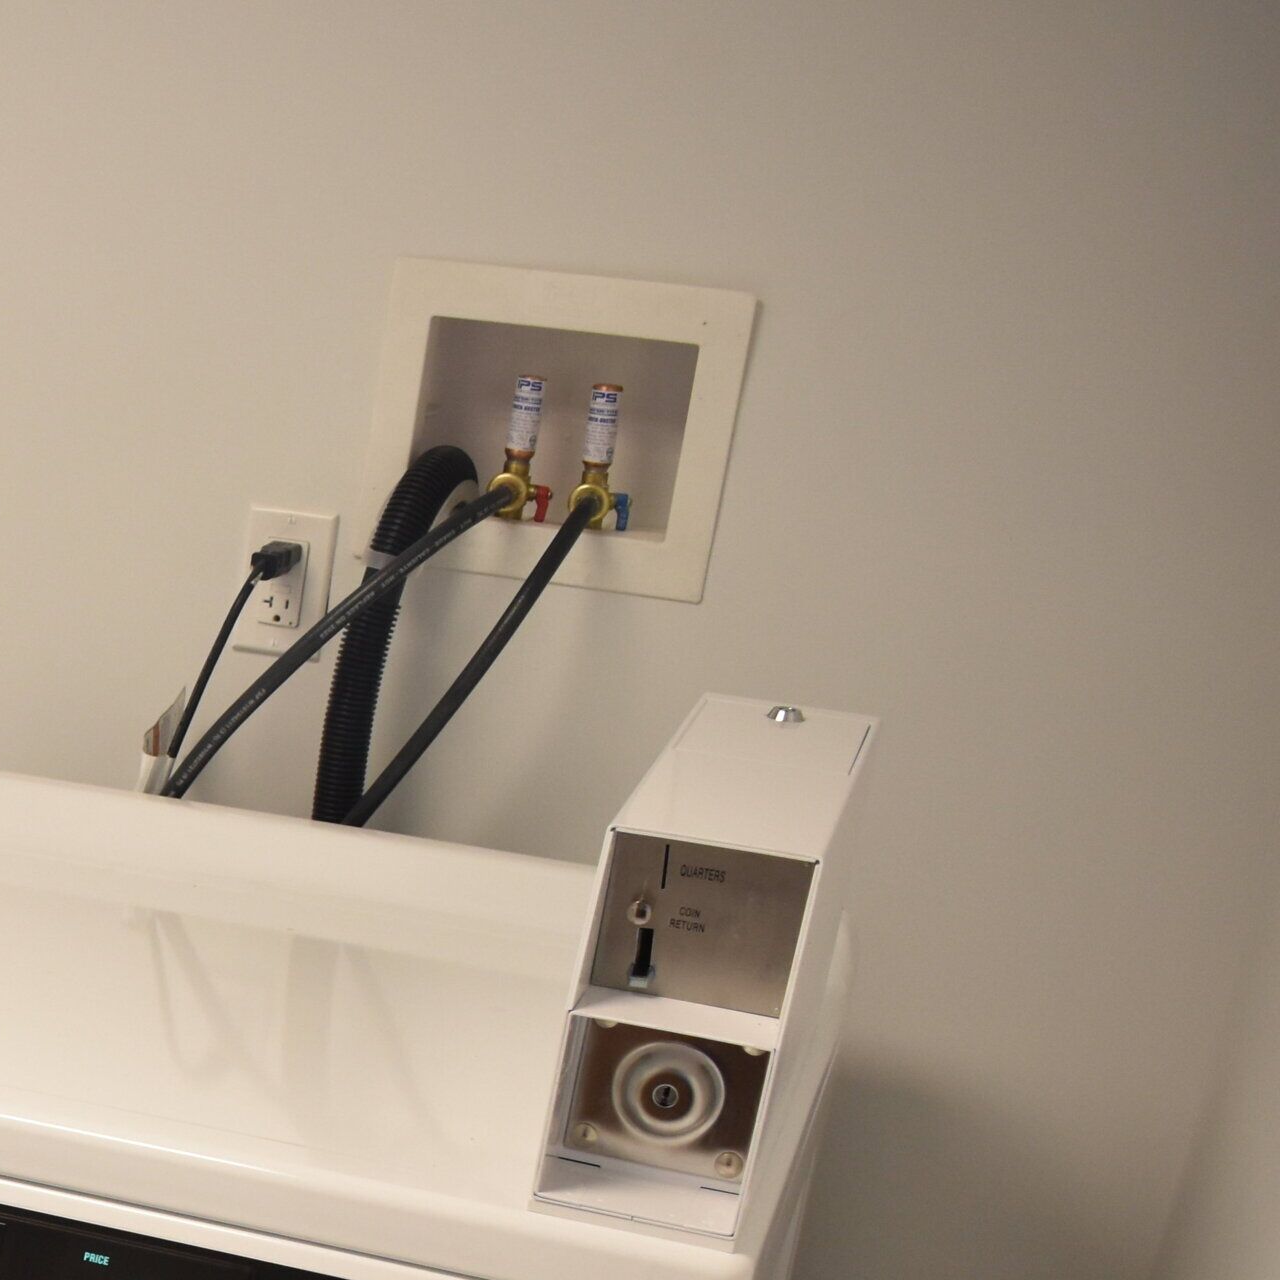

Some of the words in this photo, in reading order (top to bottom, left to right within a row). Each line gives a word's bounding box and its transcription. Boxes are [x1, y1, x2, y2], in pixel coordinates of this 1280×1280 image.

[680, 864, 726, 883] QUARTERS
[679, 907, 700, 917] COIN
[669, 918, 705, 932] RETURN
[83, 1252, 110, 1266] PRICE
